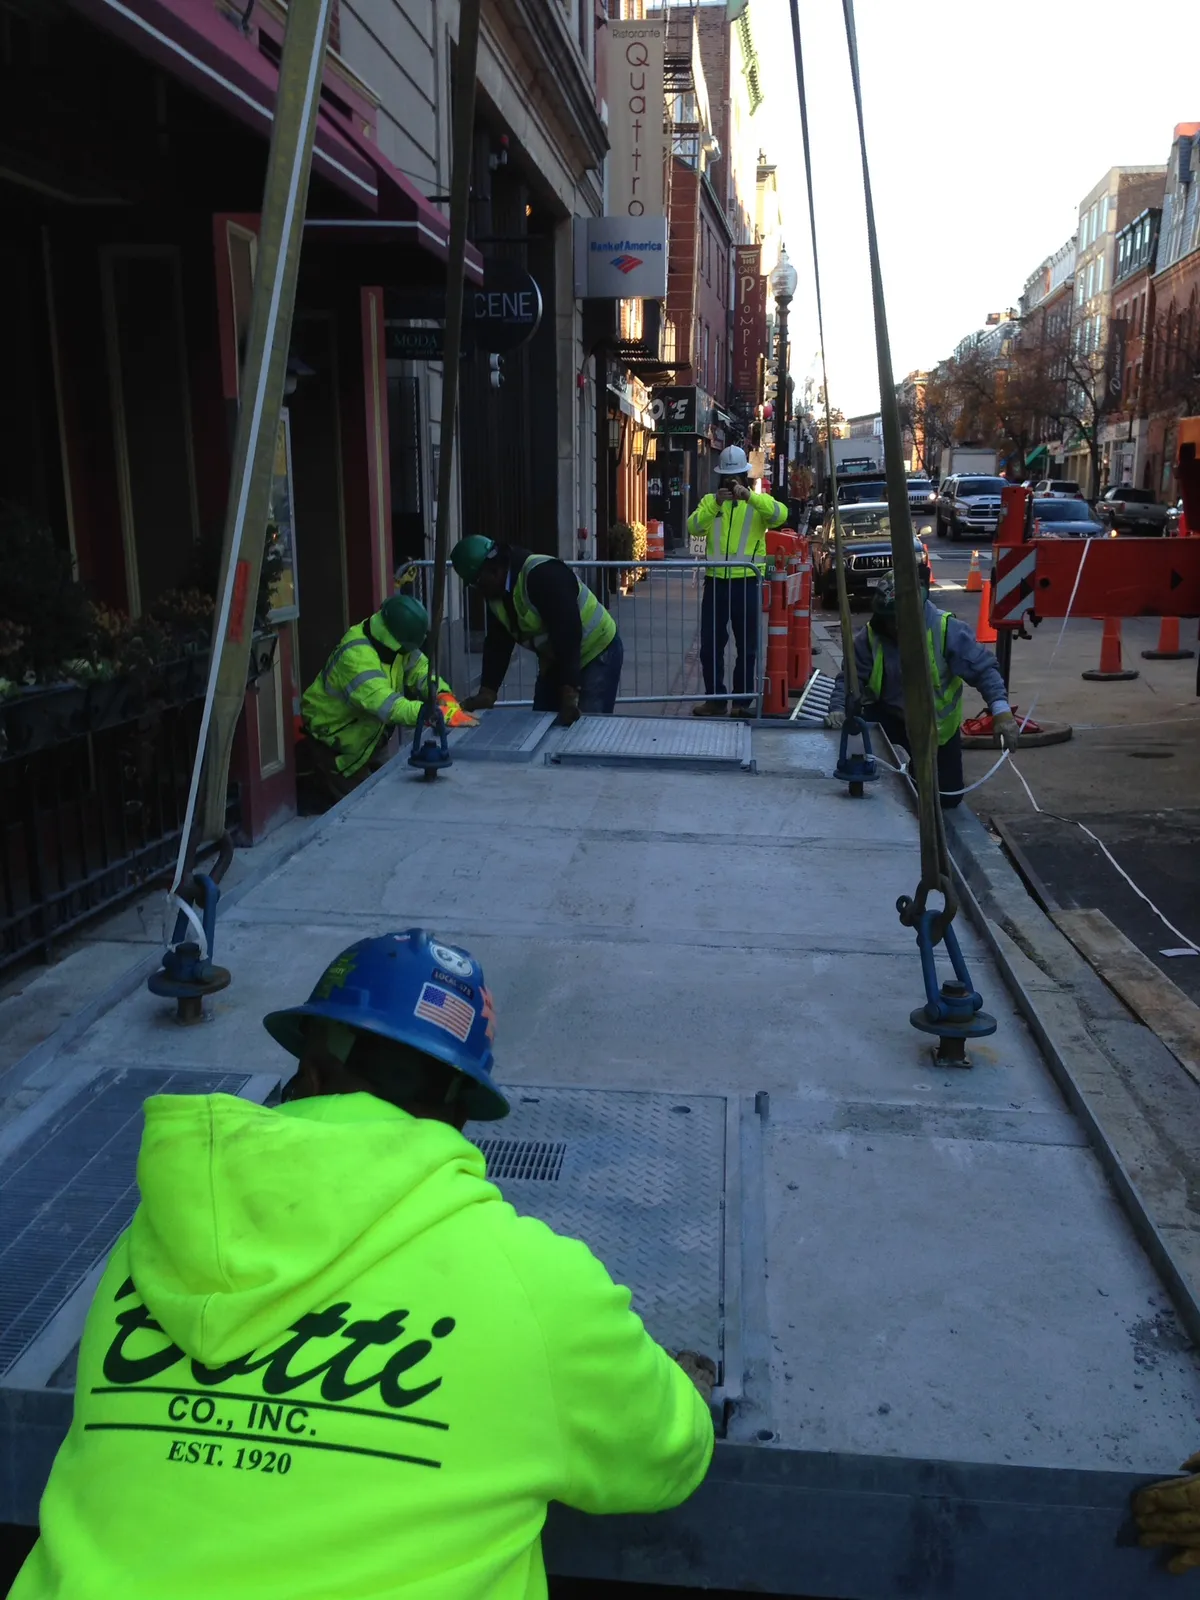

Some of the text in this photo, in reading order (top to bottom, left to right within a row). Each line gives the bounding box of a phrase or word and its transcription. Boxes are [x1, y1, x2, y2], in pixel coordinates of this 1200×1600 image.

[612, 28, 661, 39] Ristorante
[626, 42, 650, 217] Quattro
[590, 241, 662, 251] Bank of America
[394, 333, 438, 347] MODA
[434, 971, 457, 986] LOCAL
[168, 1396, 317, 1437] CO., INC.
[165, 1440, 292, 1476] EST. 1920
